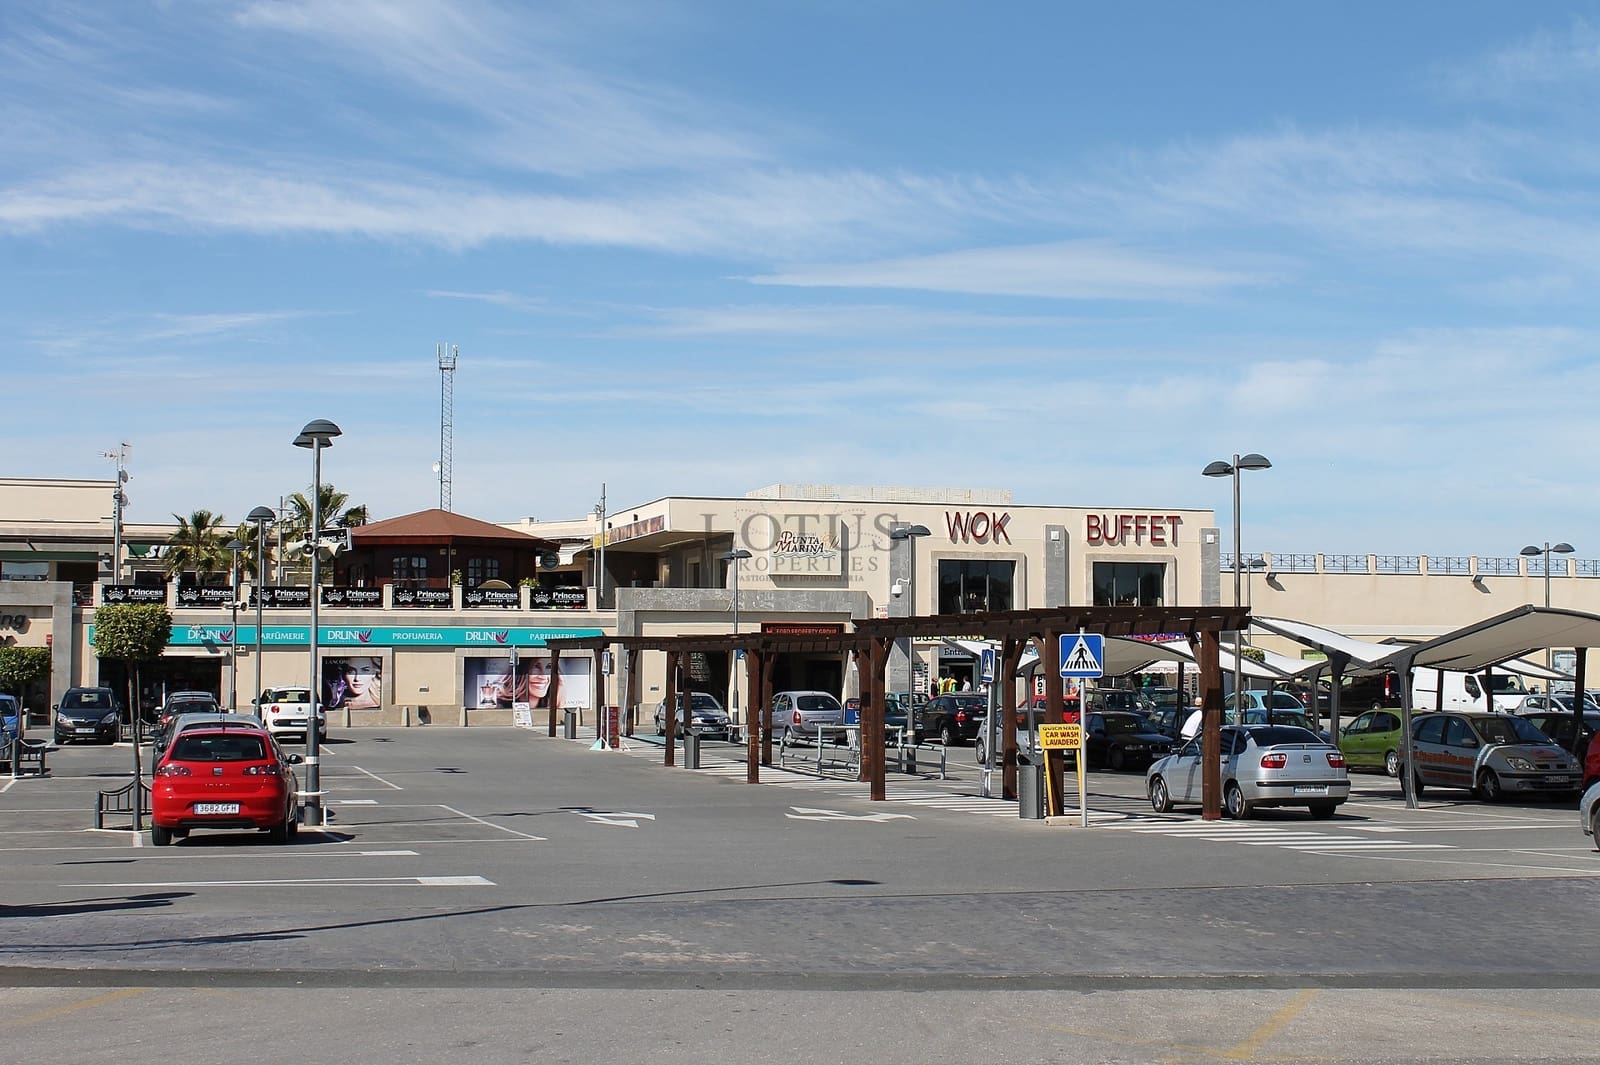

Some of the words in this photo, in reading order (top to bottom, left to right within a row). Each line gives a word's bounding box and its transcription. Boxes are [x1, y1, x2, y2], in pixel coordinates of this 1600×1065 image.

[945, 511, 1011, 541] WOK
[1086, 514, 1181, 542] BUFFET
[781, 530, 820, 544] PUNTA
[773, 540, 824, 555] MARINA
[128, 588, 164, 596] Princess
[274, 589, 309, 597] Princess
[346, 589, 380, 597] Princess
[416, 590, 450, 598] Princess
[485, 591, 518, 599] Princess
[552, 591, 585, 600] Princess
[327, 630, 360, 640] DRUNI
[392, 632, 443, 641] PROFUMERIA
[465, 631, 497, 641] DRUNI
